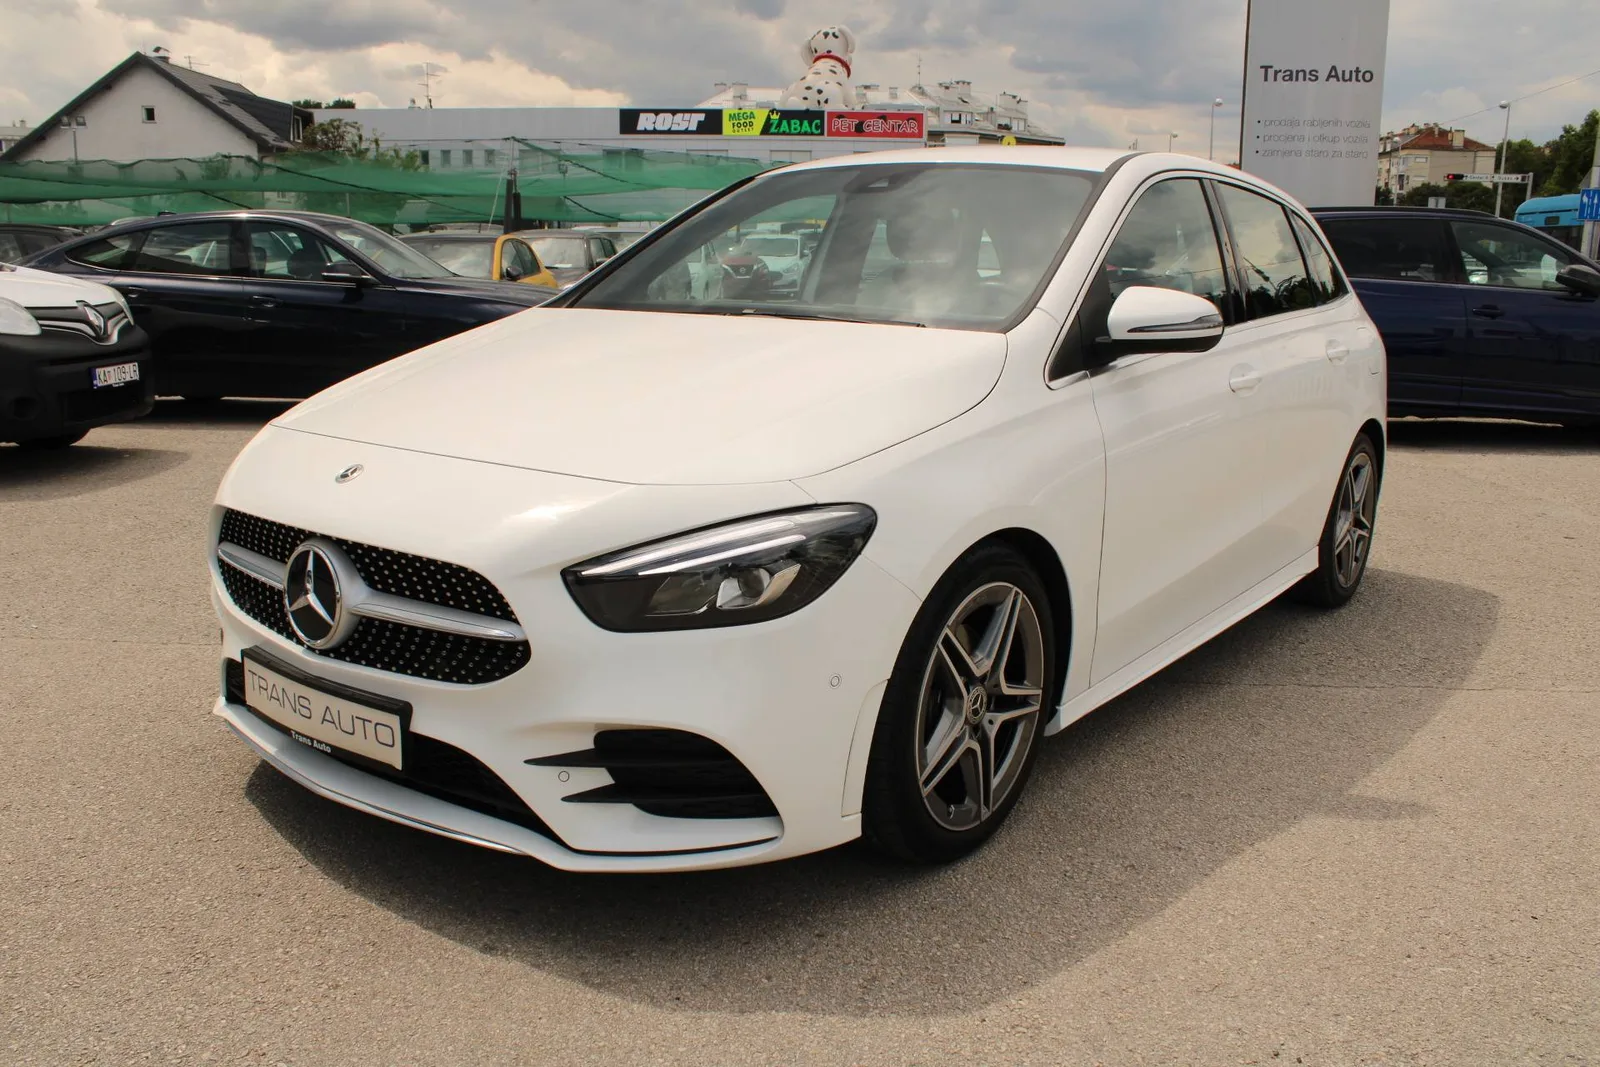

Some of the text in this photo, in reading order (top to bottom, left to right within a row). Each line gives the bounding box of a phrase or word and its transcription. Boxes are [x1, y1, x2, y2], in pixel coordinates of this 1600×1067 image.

[1260, 65, 1374, 82] Trans Auto
[637, 112, 705, 131] ROST
[728, 111, 756, 121] MEGA
[1263, 118, 1371, 128] prodaja rabljenih vozila
[732, 121, 754, 129] FOOD
[832, 118, 918, 133] PET CENTAR
[1313, 134, 1340, 144] otkup
[1343, 135, 1368, 143] vozila
[1262, 148, 1368, 159] zamjena staro za staro
[98, 368, 108, 384] KA
[248, 669, 395, 748] TRANS AUTO
[291, 730, 332, 753] Trans Auto
